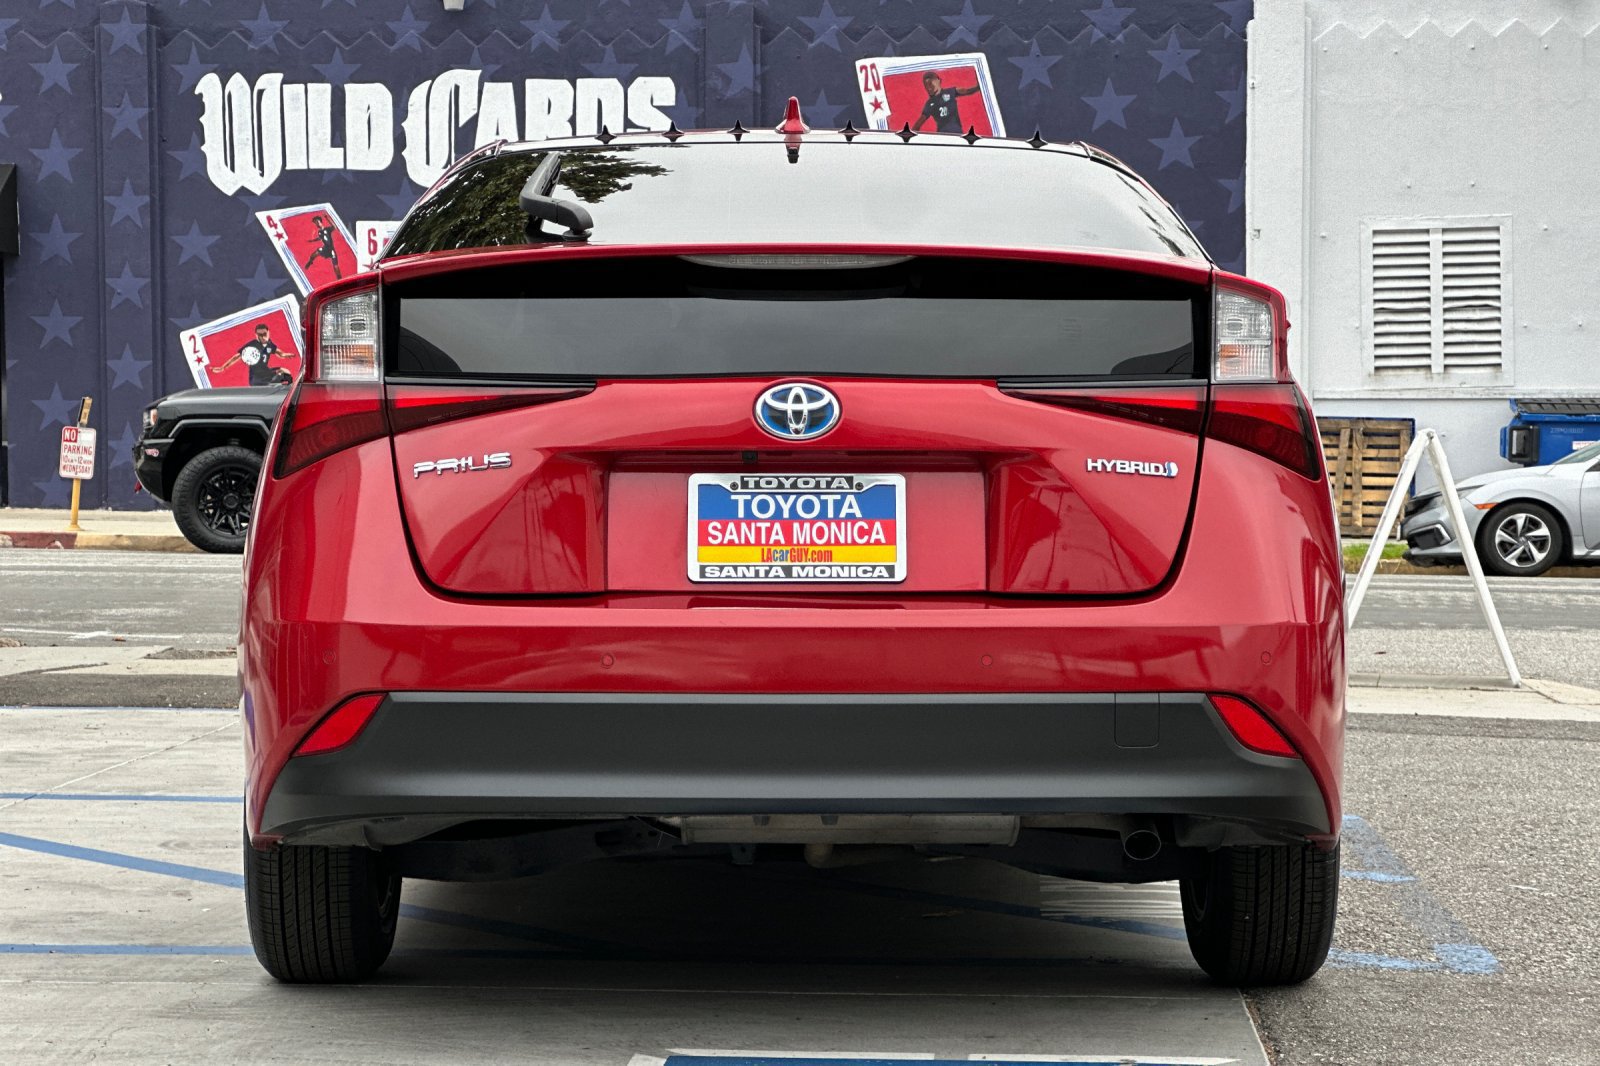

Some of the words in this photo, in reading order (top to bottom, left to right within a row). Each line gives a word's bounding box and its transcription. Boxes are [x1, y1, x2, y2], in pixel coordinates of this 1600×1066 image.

[860, 63, 881, 92] 20
[939, 106, 948, 117] 20
[194, 72, 394, 196] WILD
[266, 215, 278, 230] 4
[367, 228, 378, 255] 6
[188, 334, 199, 354] 2
[64, 429, 77, 441] NO
[63, 444, 93, 455] PARKING
[62, 464, 91, 474] WEDNESDAY
[413, 452, 511, 478] PRIUS
[1086, 458, 1164, 476] HYBRID
[743, 477, 850, 489] TOYOTA
[731, 494, 862, 519] TOYOTA
[707, 521, 785, 545] SANTA
[792, 521, 886, 545] MONICA
[761, 547, 833, 563] LAcarGUY.com
[704, 565, 786, 578] SANTA
[791, 565, 889, 578] MONICA
